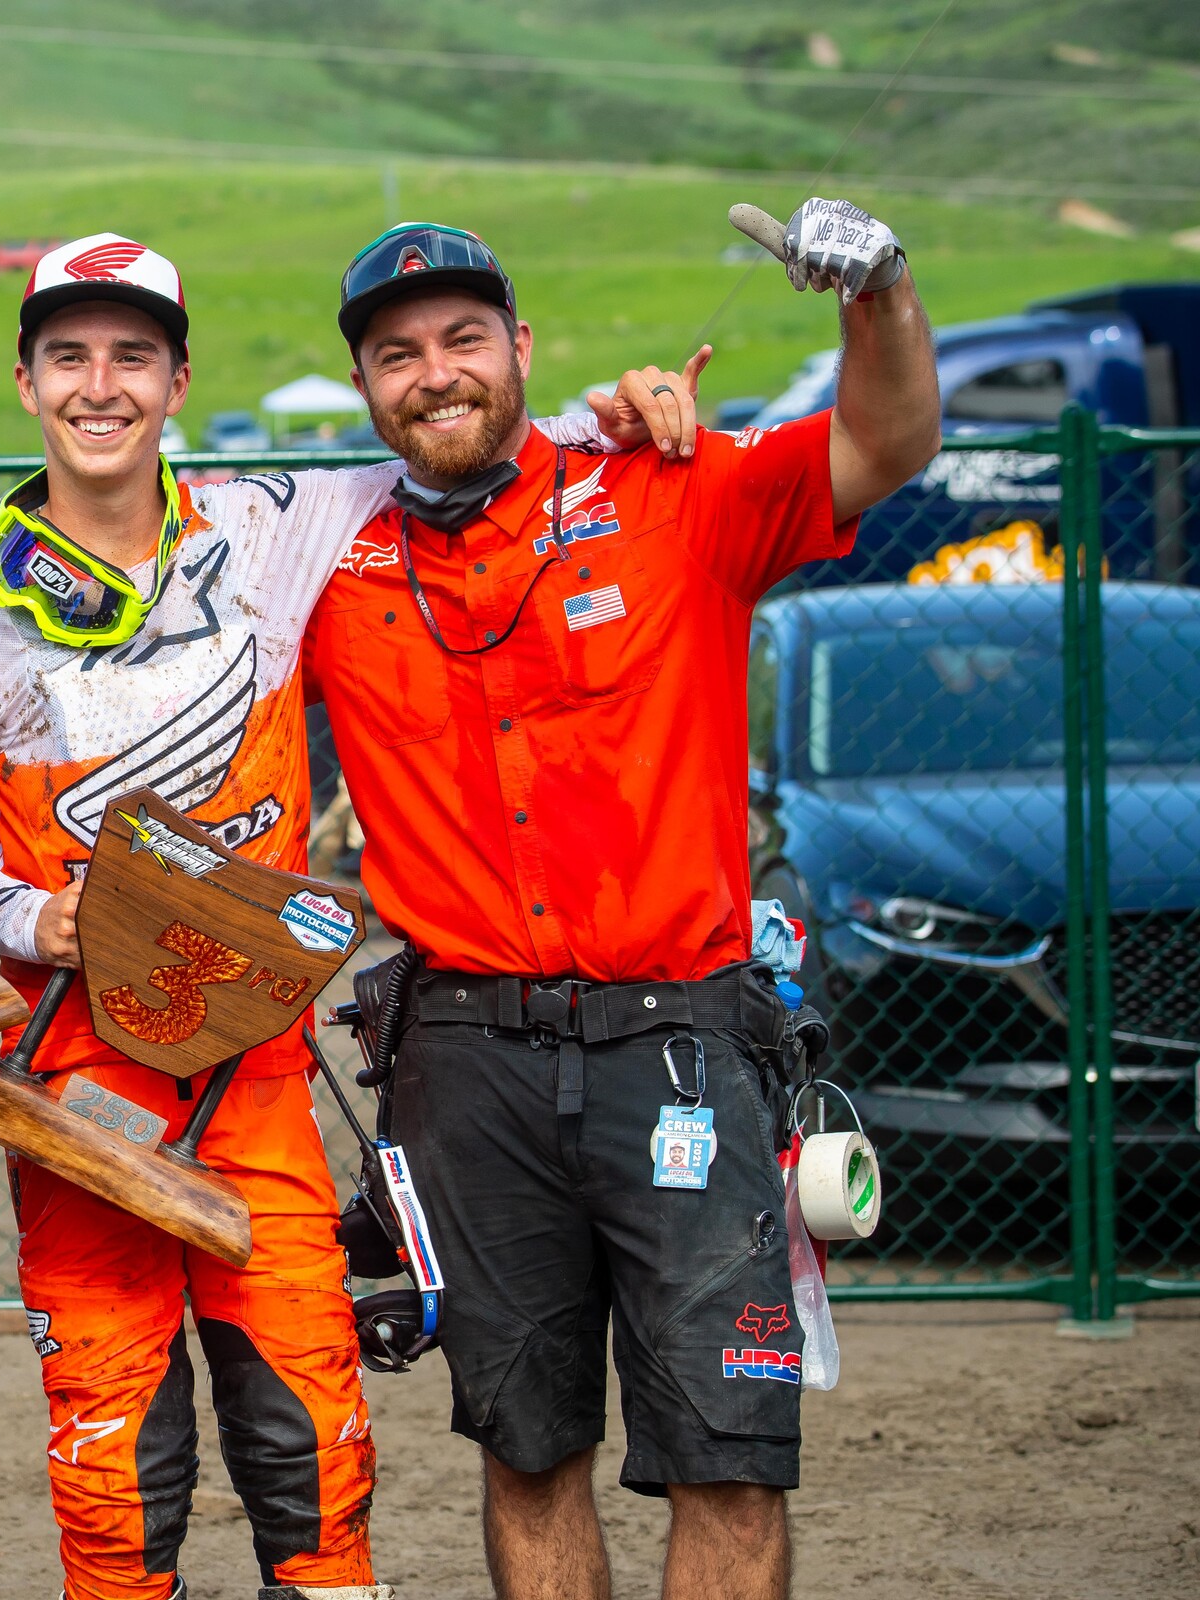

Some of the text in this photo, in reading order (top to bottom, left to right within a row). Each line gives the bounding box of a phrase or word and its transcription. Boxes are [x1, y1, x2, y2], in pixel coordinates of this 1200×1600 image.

[812, 218, 874, 250] Mehanx
[32, 558, 71, 592] 100%
[138, 817, 230, 866] Thunder
[144, 835, 215, 877] Valley
[285, 905, 349, 942] MOTOCROSS
[300, 895, 348, 923] LUCAS OIL
[98, 919, 312, 1046] 3rd
[66, 1083, 159, 1144] 250
[664, 1120, 707, 1133] CREW
[692, 1142, 703, 1167] 2021
[722, 1347, 802, 1385] HRC
